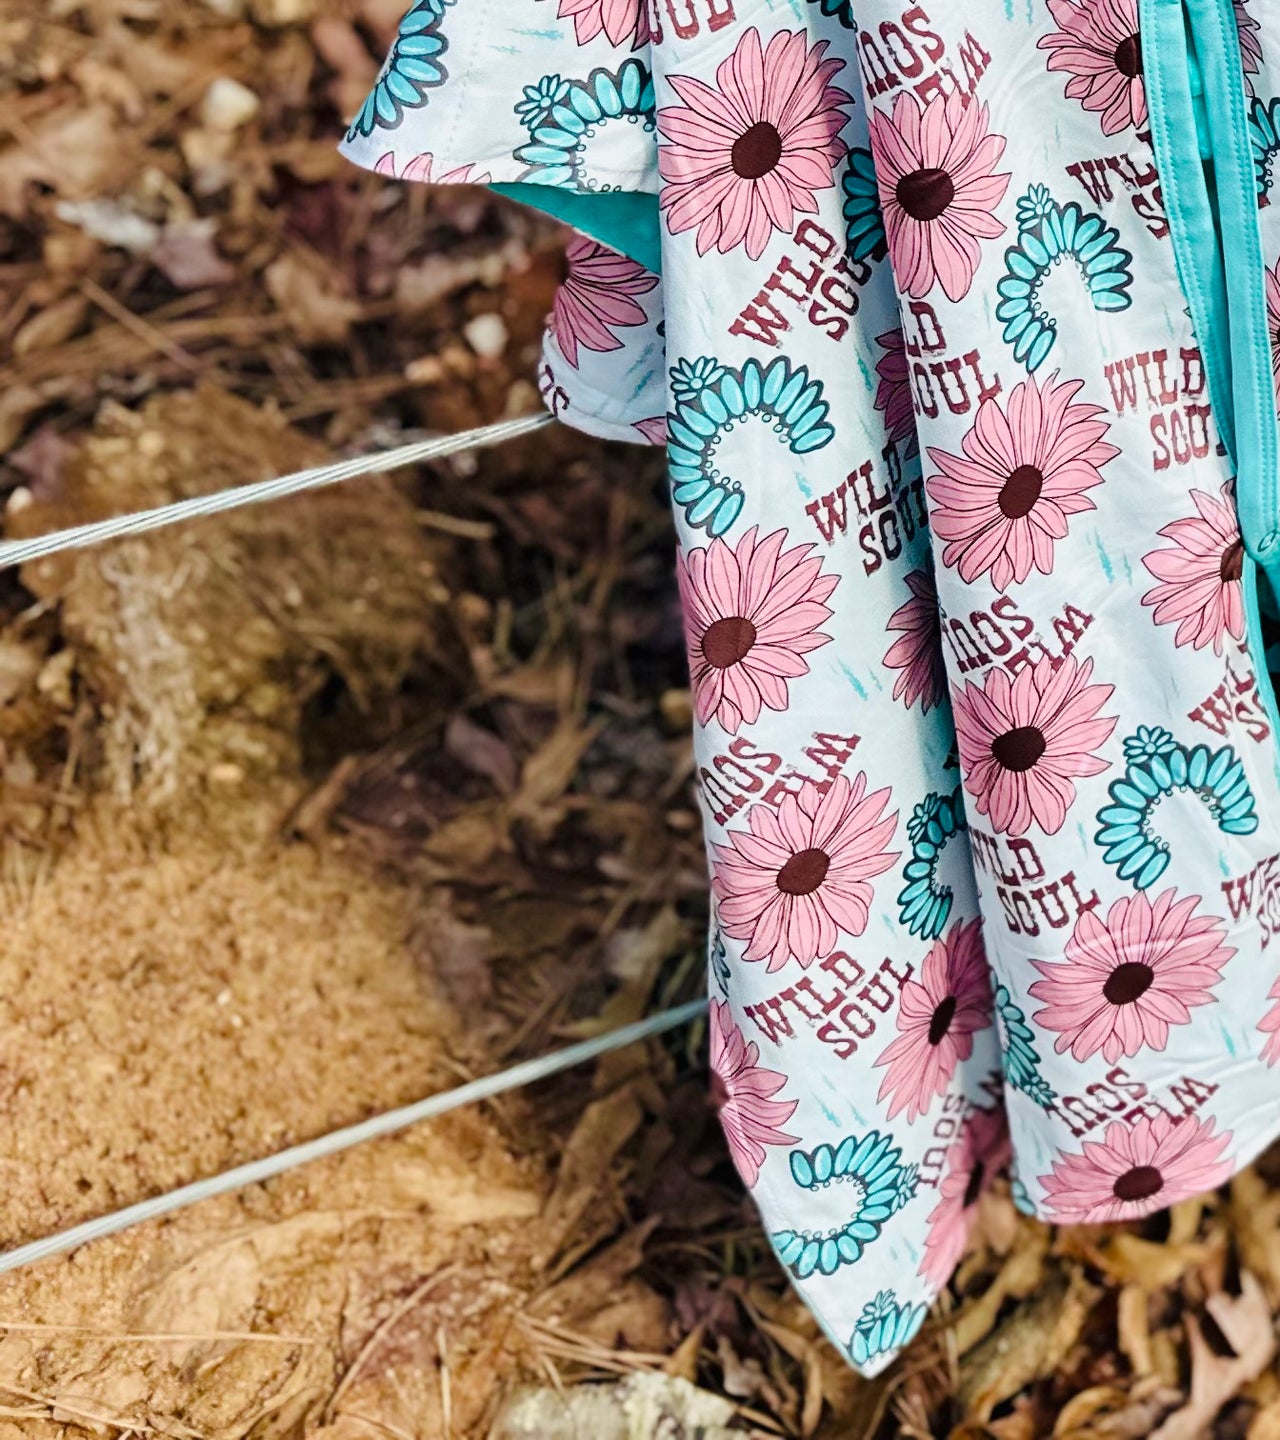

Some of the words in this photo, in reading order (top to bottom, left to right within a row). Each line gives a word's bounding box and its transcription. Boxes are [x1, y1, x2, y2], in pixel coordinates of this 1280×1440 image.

[857, 6, 948, 101] SOU
[728, 219, 836, 348] WILD
[807, 250, 885, 342] SOU
[912, 348, 1002, 419] OUL
[1104, 348, 1206, 416] WILD
[1150, 403, 1226, 472] SOU
[942, 596, 1034, 672] SOU
[744, 950, 865, 1047] WILD
[817, 958, 916, 1060] SOUL
